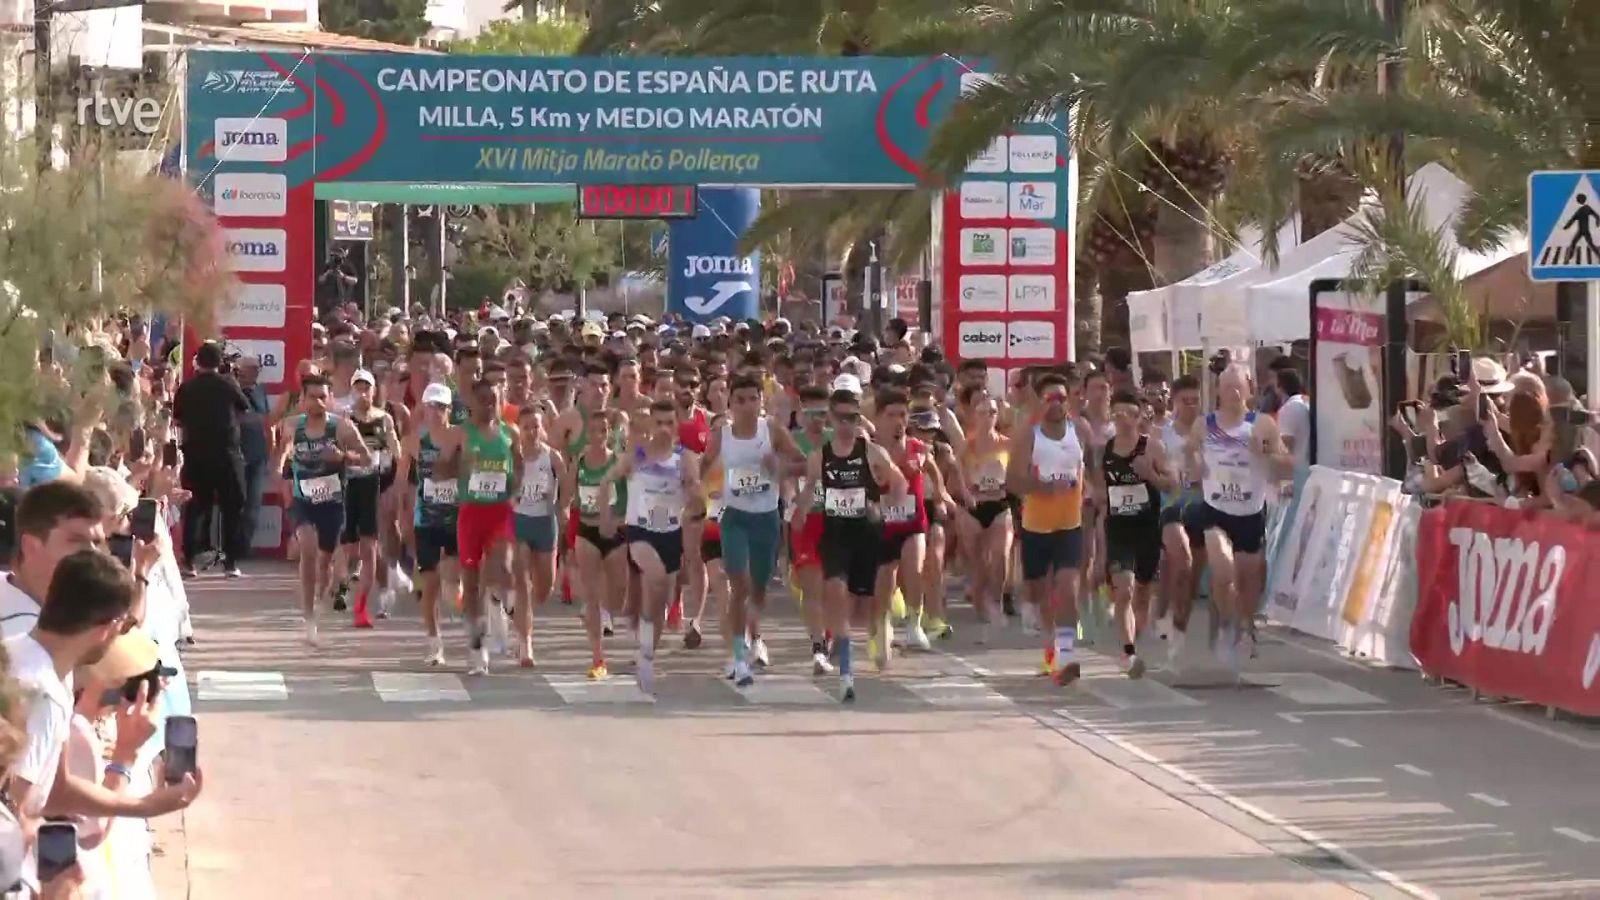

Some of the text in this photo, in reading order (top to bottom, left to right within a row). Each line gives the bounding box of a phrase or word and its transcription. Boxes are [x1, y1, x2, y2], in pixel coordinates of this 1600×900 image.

[377, 66, 878, 94] CAMPEONATO DE ESPAÑA DE RUTA
[419, 103, 822, 132] MILLA, 5 Km y MEDIO MARATÓN
[474, 147, 761, 175] XVI Mitja Marató Pollença
[1019, 198, 1045, 211] Mar
[684, 255, 754, 277] Joma
[962, 330, 1002, 344] cabot
[1448, 527, 1566, 657] Joma
